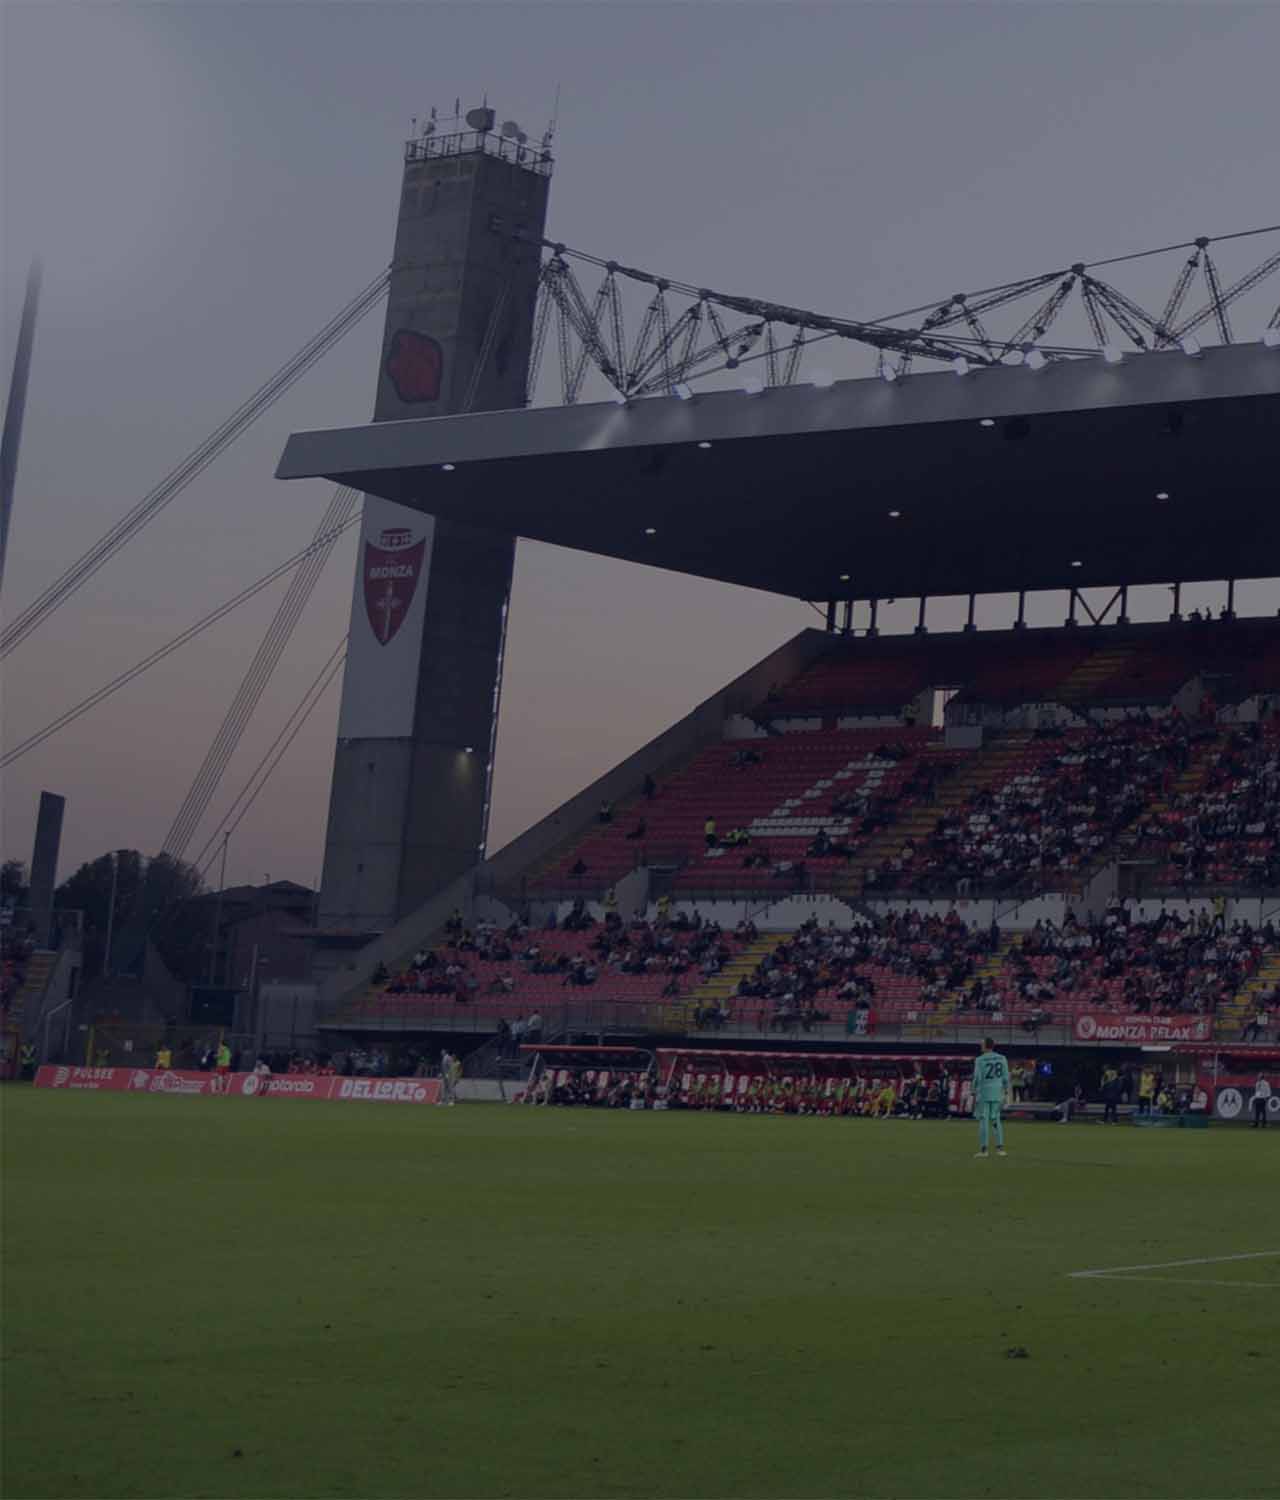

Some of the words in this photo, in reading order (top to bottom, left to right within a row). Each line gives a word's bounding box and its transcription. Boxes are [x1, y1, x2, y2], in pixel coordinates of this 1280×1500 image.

[369, 565, 414, 578] MONZA
[1096, 1025, 1147, 1040] MONZA
[985, 1062, 1003, 1080] 28
[259, 1079, 314, 1093] motorola
